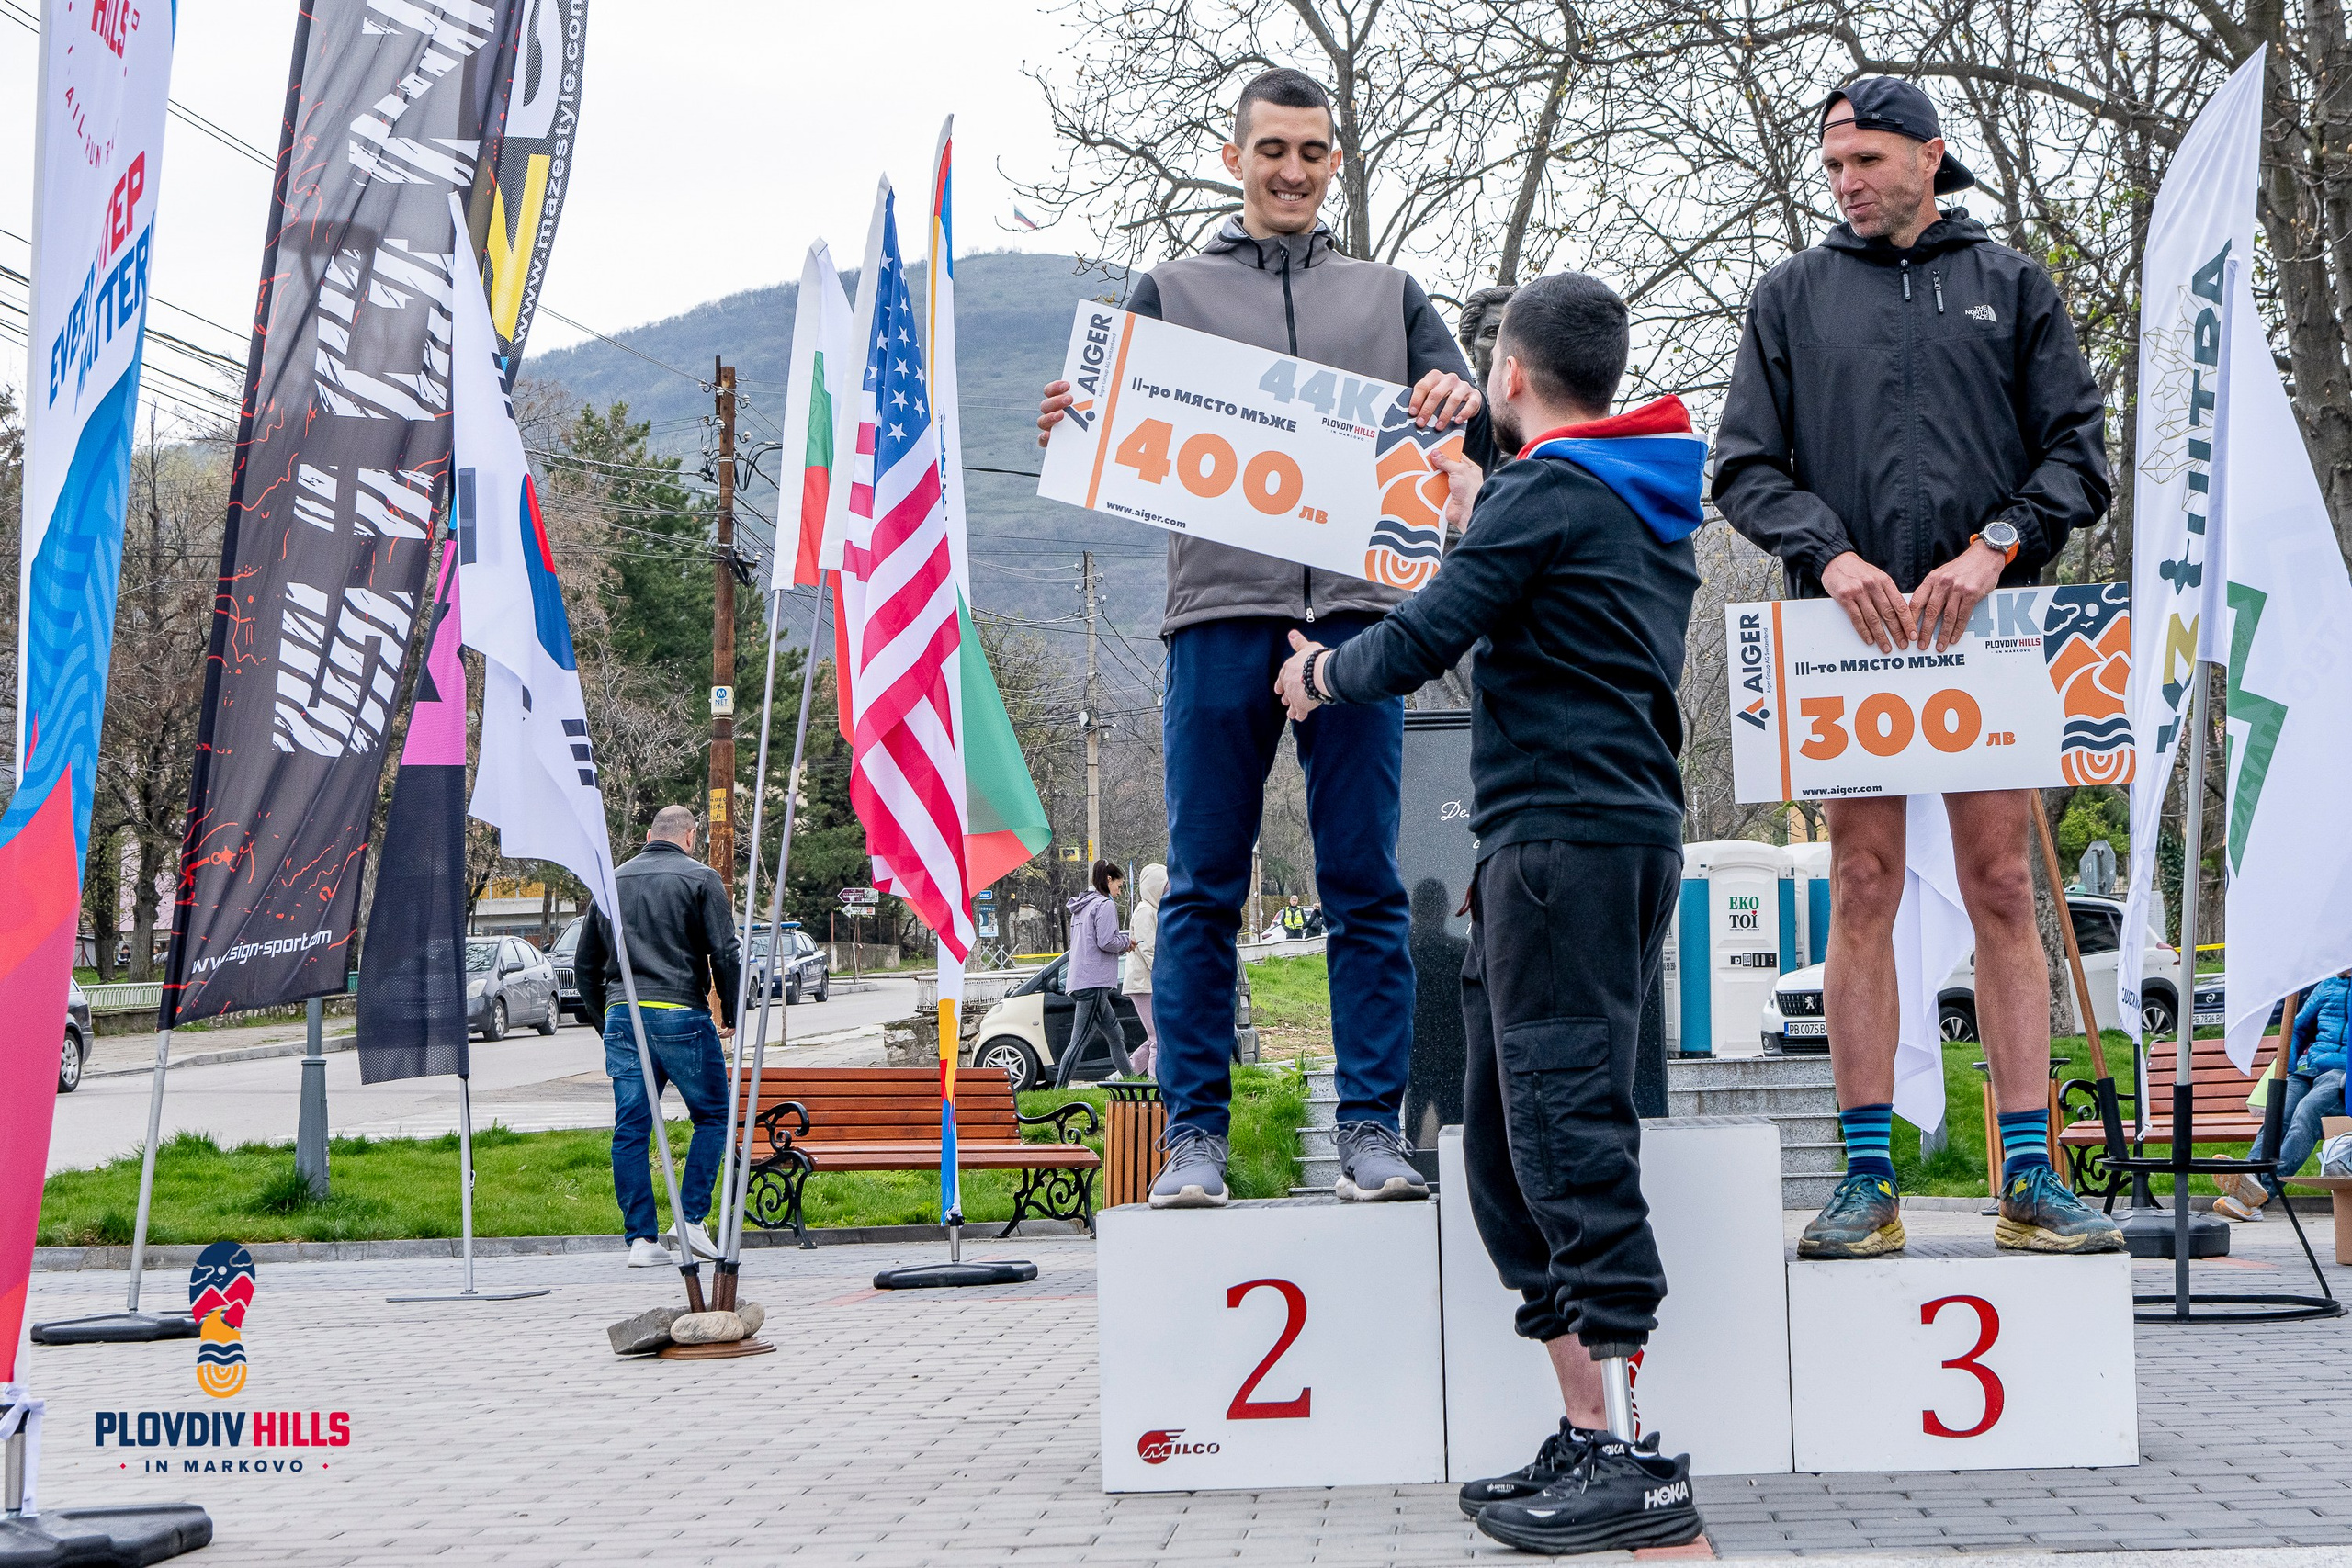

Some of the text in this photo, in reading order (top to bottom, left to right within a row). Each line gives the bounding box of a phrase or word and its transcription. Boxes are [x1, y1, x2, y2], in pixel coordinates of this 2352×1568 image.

[96, 151, 144, 292] TEP
[74, 209, 155, 415] ATTER
[1077, 313, 1113, 396] AIGER
[1174, 389, 1238, 416] МЯСТО
[1240, 407, 1297, 433] МЪЖЕ
[1258, 358, 1385, 428] 44K
[1321, 417, 1376, 438] PLOVDIV HILLS
[1114, 417, 1304, 515] 400
[1106, 502, 1186, 529] www.aiger.com
[1933, 592, 2041, 640] 4K
[1739, 612, 1764, 694] AIGER
[1840, 657, 1905, 672] МЯСТО
[1907, 654, 1965, 669] МЪЖЕ
[1985, 637, 2041, 649] PLOVDIV HILLS
[1799, 688, 1982, 760] 300
[1802, 784, 1883, 796] www.aiger.com
[1728, 897, 1759, 909] EKO
[1789, 1024, 1800, 1034] PB
[1801, 1024, 1819, 1034] 0075
[1227, 1279, 1311, 1420] 2
[1920, 1294, 2005, 1438] 3
[1140, 1441, 1220, 1459] MILCO
[1600, 1443, 1625, 1456] OKA
[1645, 1481, 1690, 1509] HOKA
